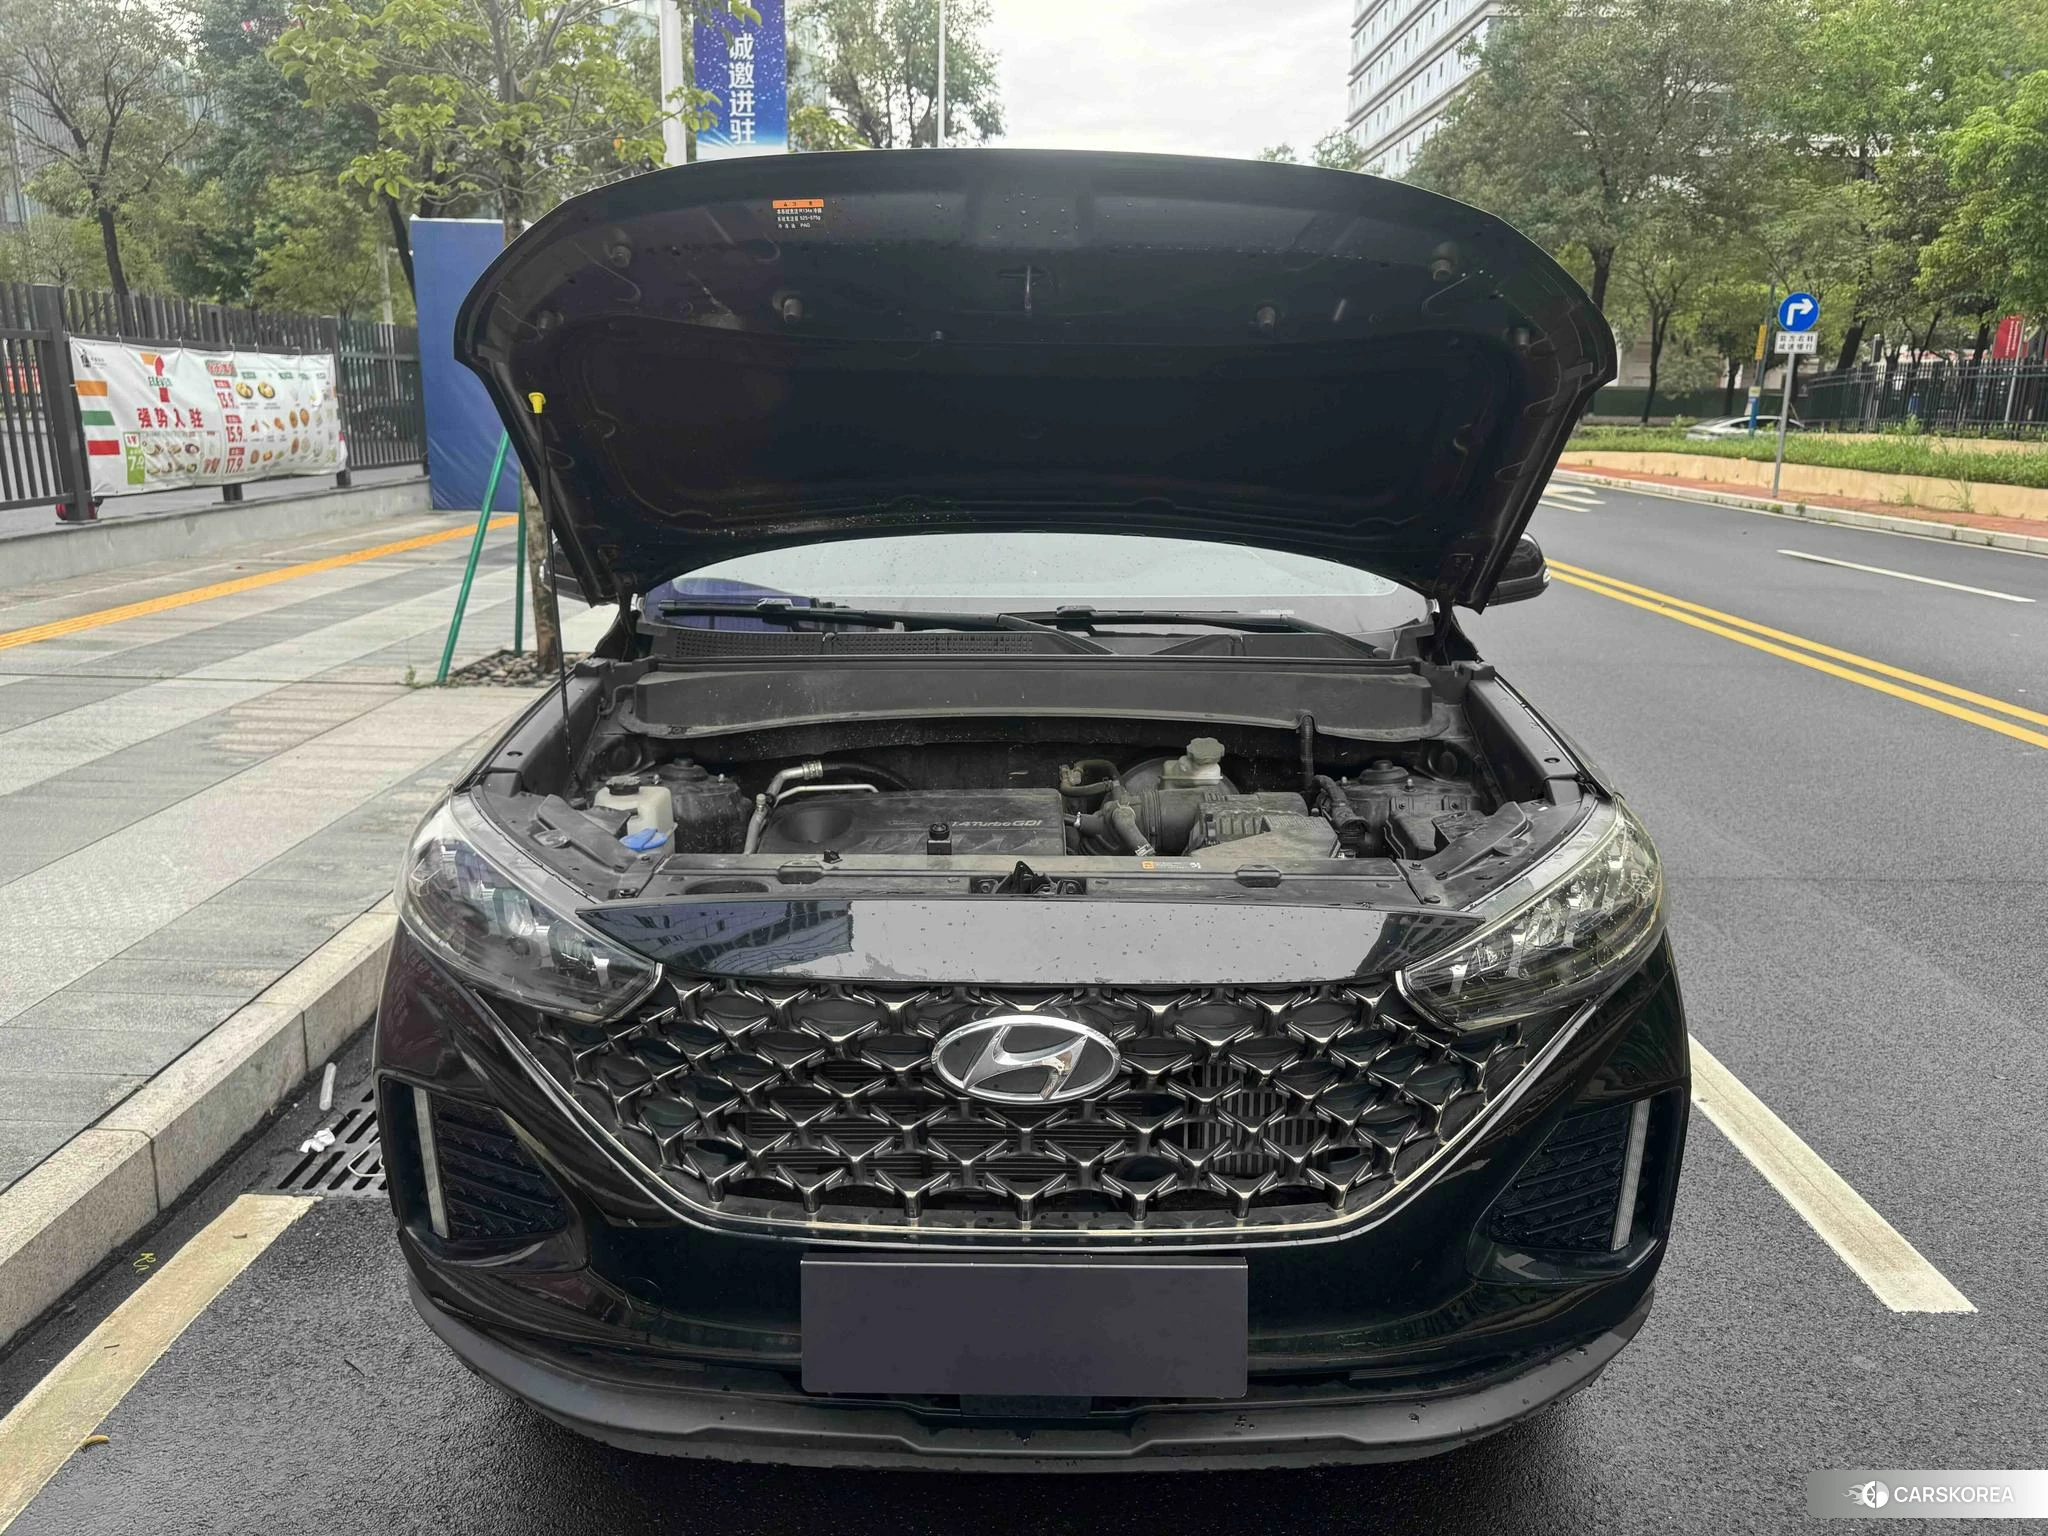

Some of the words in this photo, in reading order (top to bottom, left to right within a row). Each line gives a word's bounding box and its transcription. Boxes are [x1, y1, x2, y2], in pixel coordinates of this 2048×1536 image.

[728, 33, 755, 145] 诚邀进驻
[137, 407, 203, 428] 强势入驻
[225, 426, 243, 443] 15.9
[225, 457, 243, 474] 17.9
